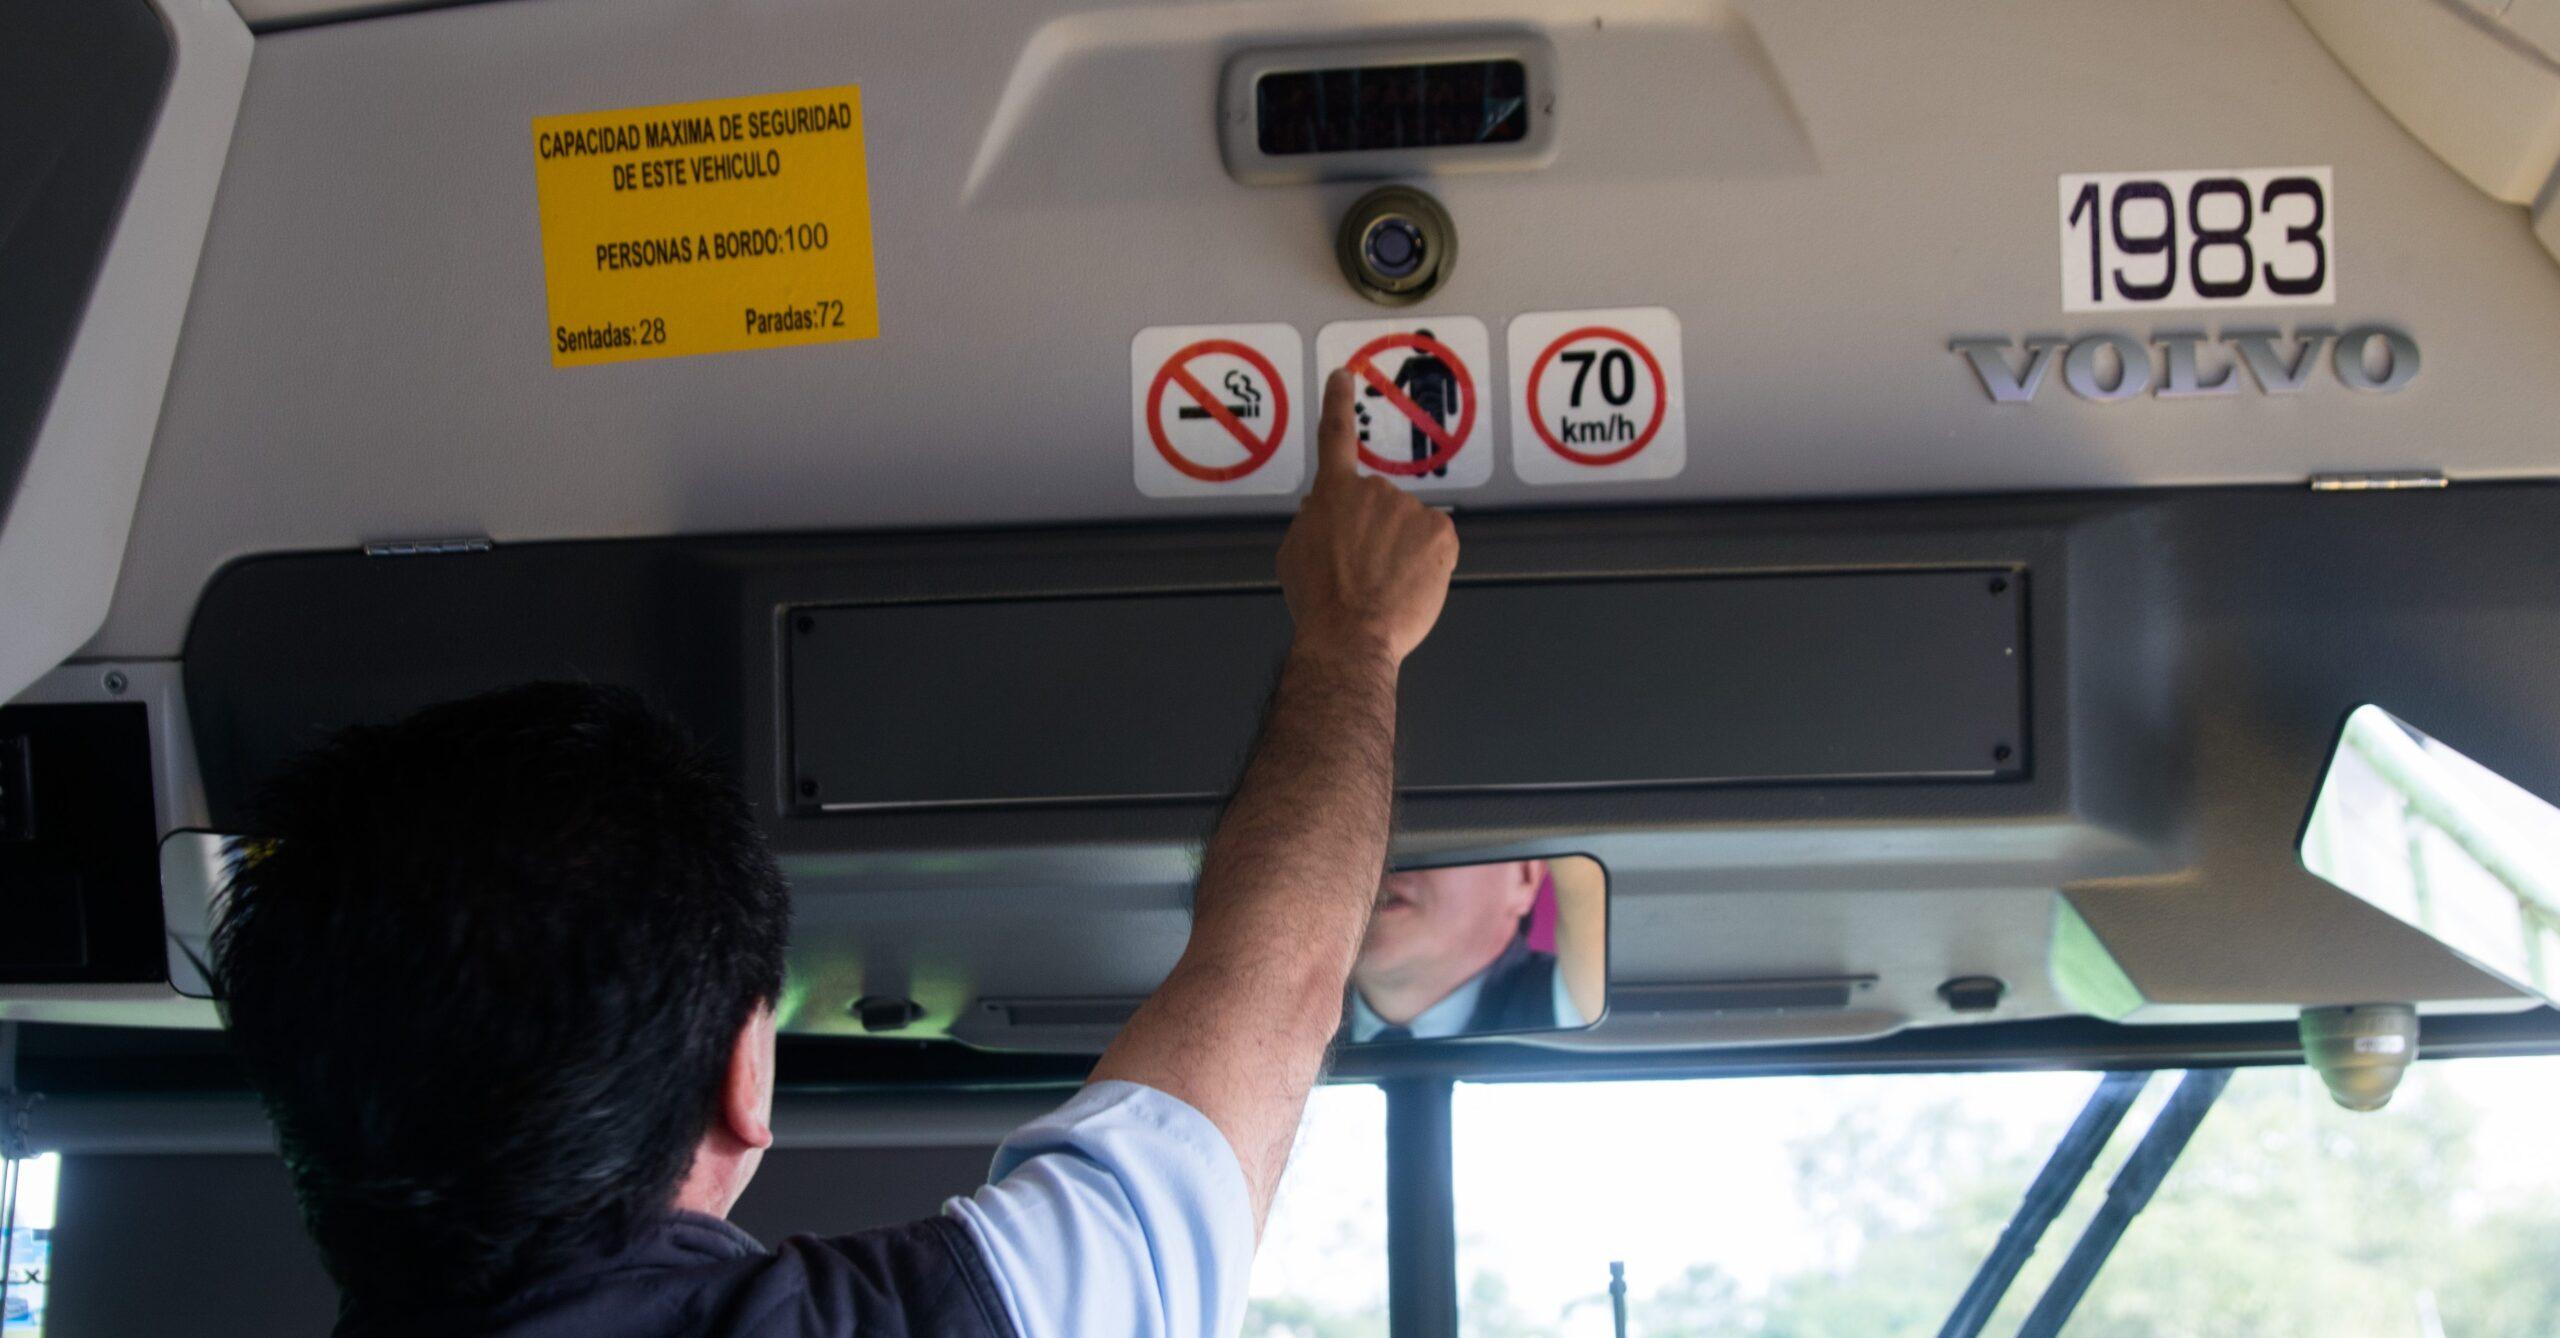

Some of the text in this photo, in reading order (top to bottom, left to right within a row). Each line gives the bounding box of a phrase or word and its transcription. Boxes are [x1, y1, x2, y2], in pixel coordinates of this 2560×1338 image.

[540, 102, 852, 160] CAPACIDAD MAXIMA DE SEGURIDAD
[613, 149, 780, 192] DE ESTE VEHICULO
[596, 235, 692, 271] PERSONAS
[697, 234, 710, 261] A
[2068, 177, 2326, 302] 1983
[1560, 348, 1635, 407] 70
[1948, 321, 2421, 402] VOLVO
[1561, 413, 1636, 443] km/h
